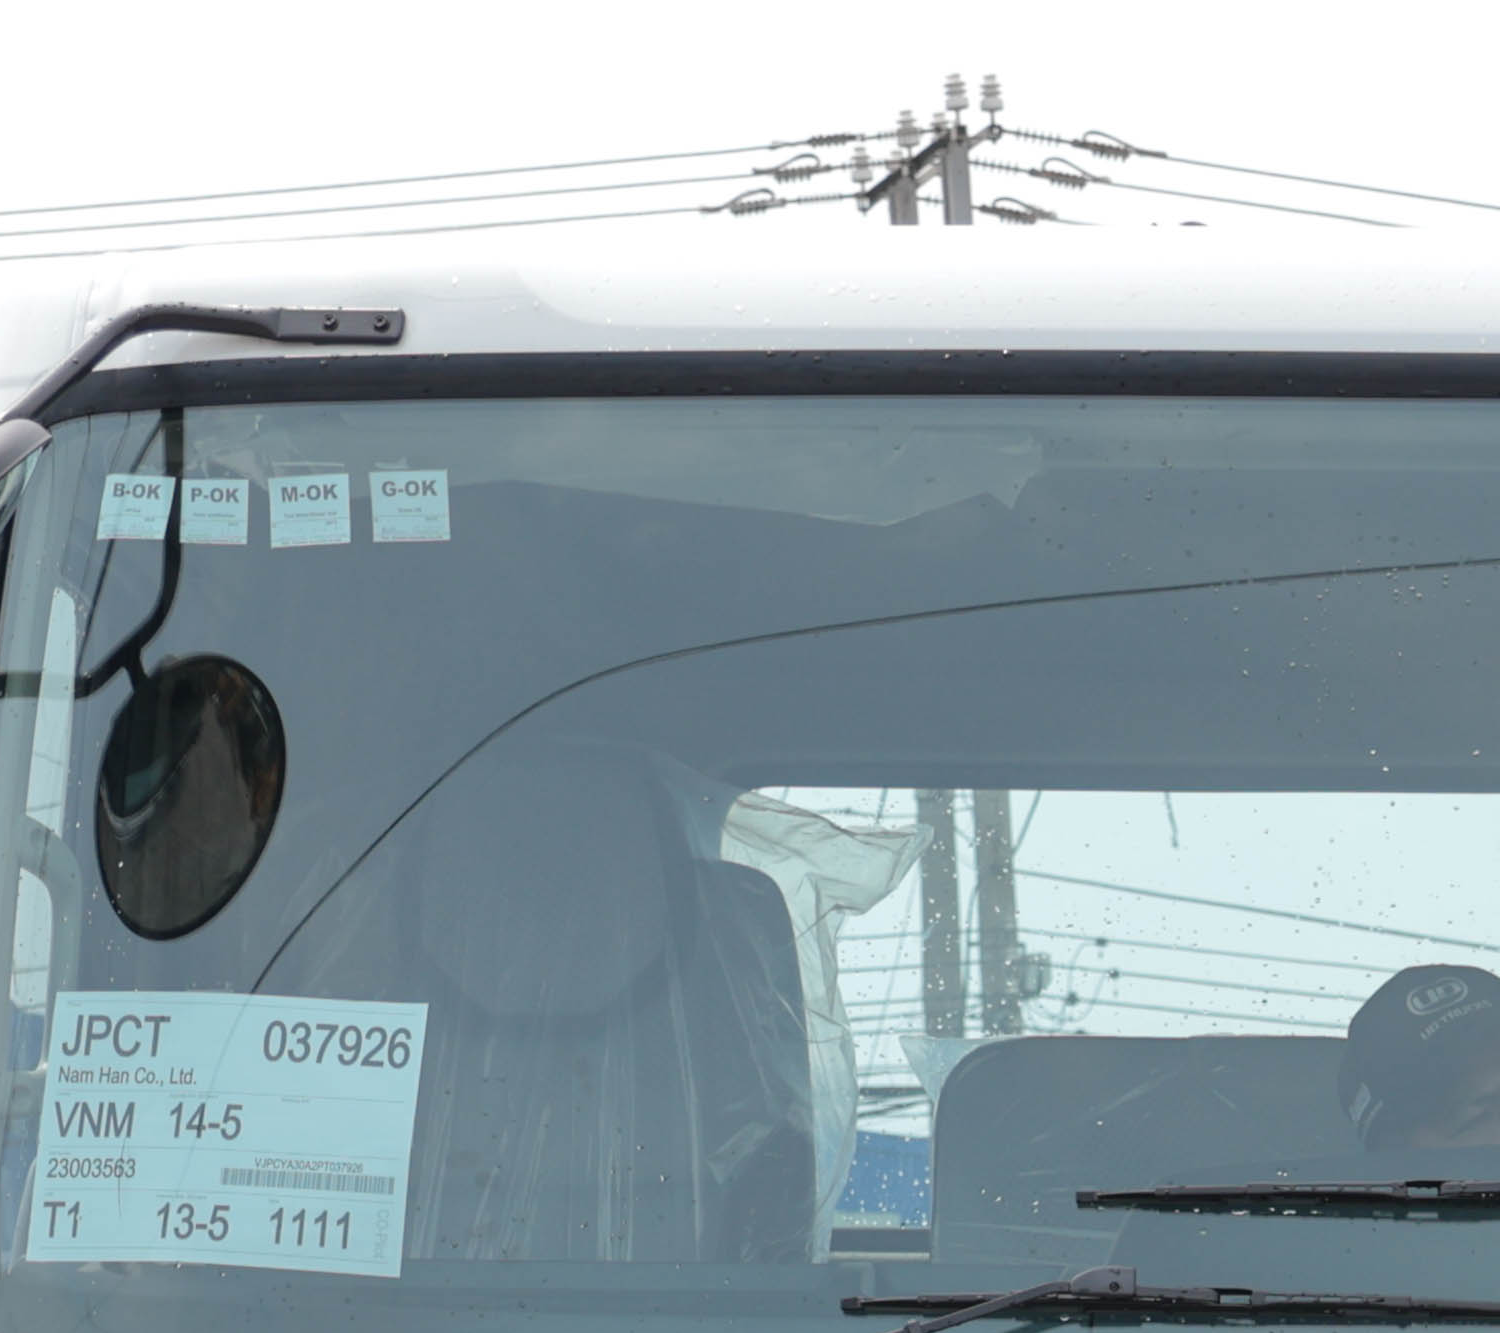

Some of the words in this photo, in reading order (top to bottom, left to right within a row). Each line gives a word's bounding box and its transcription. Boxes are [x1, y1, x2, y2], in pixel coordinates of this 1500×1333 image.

[113, 483, 162, 499] B-OK
[191, 487, 239, 503] P-OK
[281, 484, 338, 502] M-OK
[381, 480, 438, 497] G-OK
[62, 1014, 171, 1058] JPCT
[263, 1019, 413, 1069] 037926
[58, 1066, 94, 1084] Nam
[99, 1066, 129, 1084] Han
[134, 1066, 164, 1087] Co.,
[169, 1067, 197, 1085] Ltd.
[55, 1101, 135, 1139] VNM
[168, 1102, 243, 1141] 14-5
[46, 1157, 136, 1179] 23003563
[43, 1201, 81, 1239] T1
[156, 1202, 231, 1241] 13-5
[269, 1207, 351, 1250] 1111
